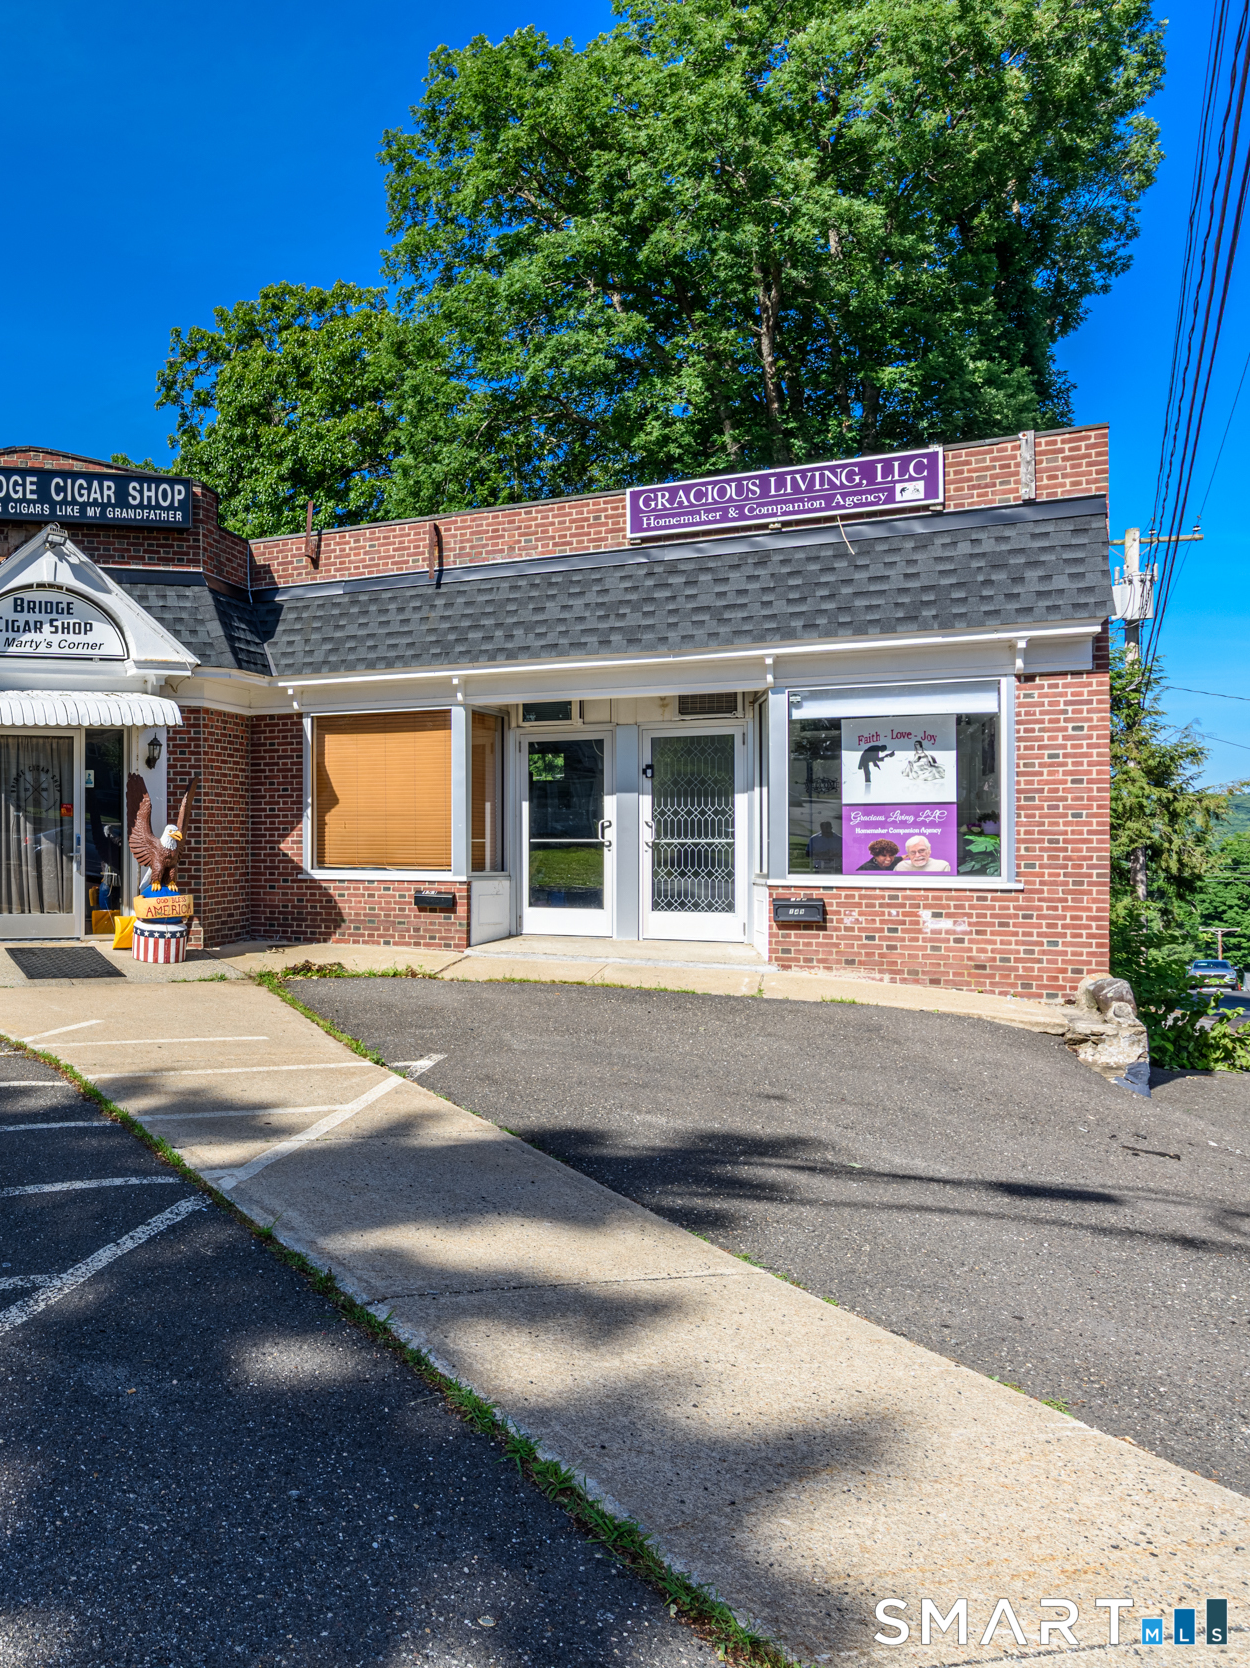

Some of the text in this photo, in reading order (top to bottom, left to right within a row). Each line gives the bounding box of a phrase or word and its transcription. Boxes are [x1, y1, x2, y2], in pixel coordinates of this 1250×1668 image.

[51, 477, 115, 503] CIGAR
[128, 482, 185, 507] SHOP
[639, 458, 928, 511] GRACIOUS LIVING, LLC
[8, 502, 50, 514] CIGARS
[57, 504, 80, 516] LIKE
[87, 506, 101, 517] MY
[106, 507, 183, 521] GRANDFATHER
[642, 492, 888, 528] Homemaker & Companion Agency
[3, 637, 53, 651] Marty's
[58, 639, 104, 651] Corner
[857, 731, 881, 746] Faith
[890, 729, 912, 740] Love
[920, 730, 937, 745] Joy
[850, 809, 948, 825] Gracious Living LLC
[888, 827, 919, 835] Companion
[920, 827, 942, 835] Agency
[146, 904, 191, 917] AMERICA
